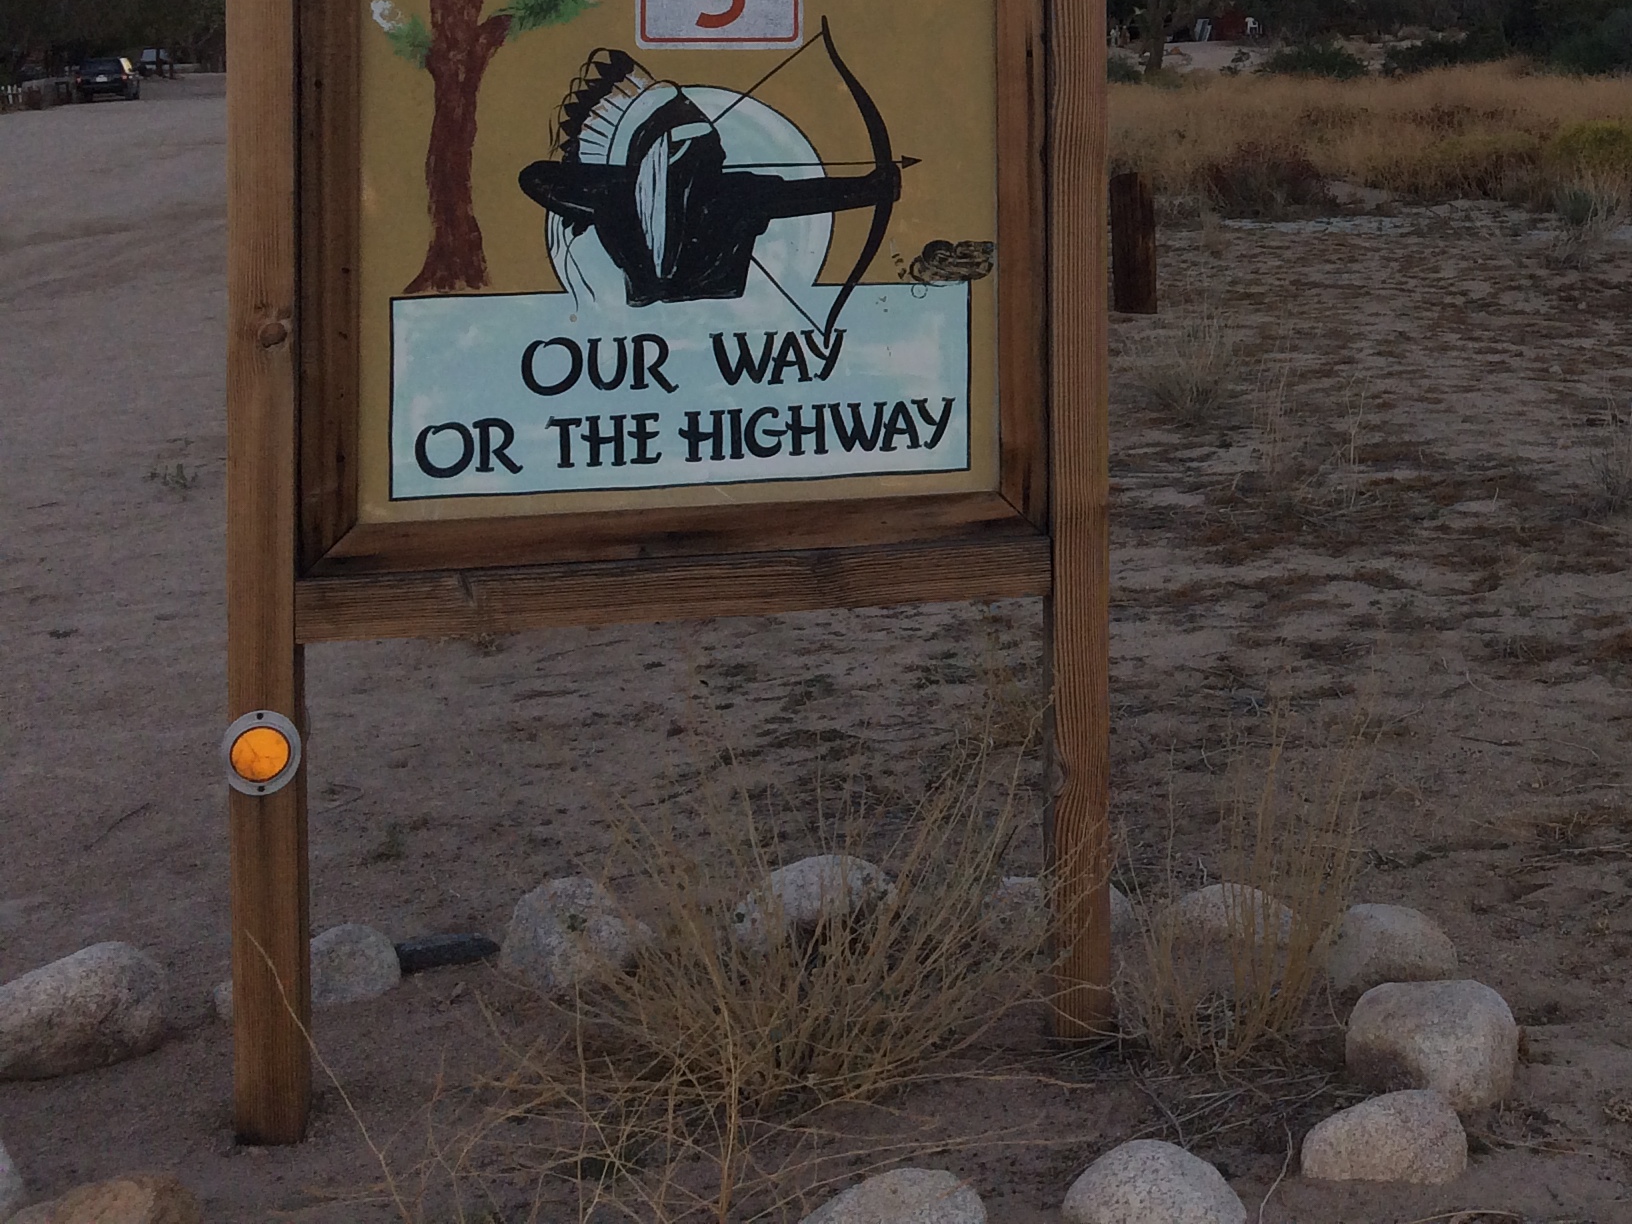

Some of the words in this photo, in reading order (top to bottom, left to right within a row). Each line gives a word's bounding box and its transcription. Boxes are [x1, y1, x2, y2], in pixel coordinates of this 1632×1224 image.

[521, 333, 679, 396] OUR
[709, 328, 847, 386] WAY
[414, 418, 524, 478] OR
[544, 412, 661, 470] THE
[678, 397, 956, 463] HIGHWAY
